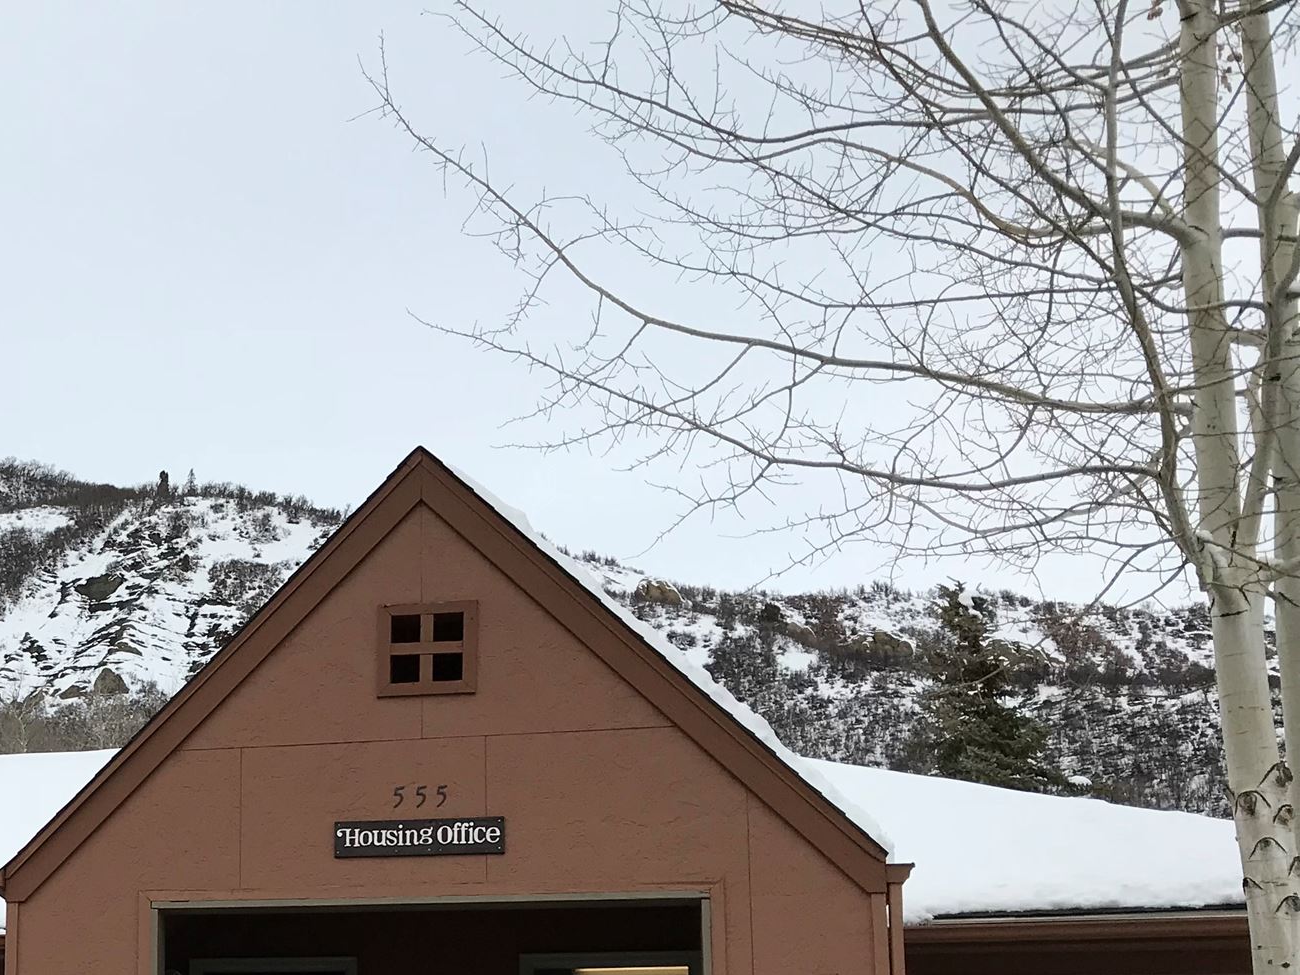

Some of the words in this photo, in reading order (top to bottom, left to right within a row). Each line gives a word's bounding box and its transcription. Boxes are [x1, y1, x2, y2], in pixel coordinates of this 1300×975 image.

[393, 784, 448, 809] 555
[336, 824, 433, 848] Housing
[436, 821, 501, 845] Office
